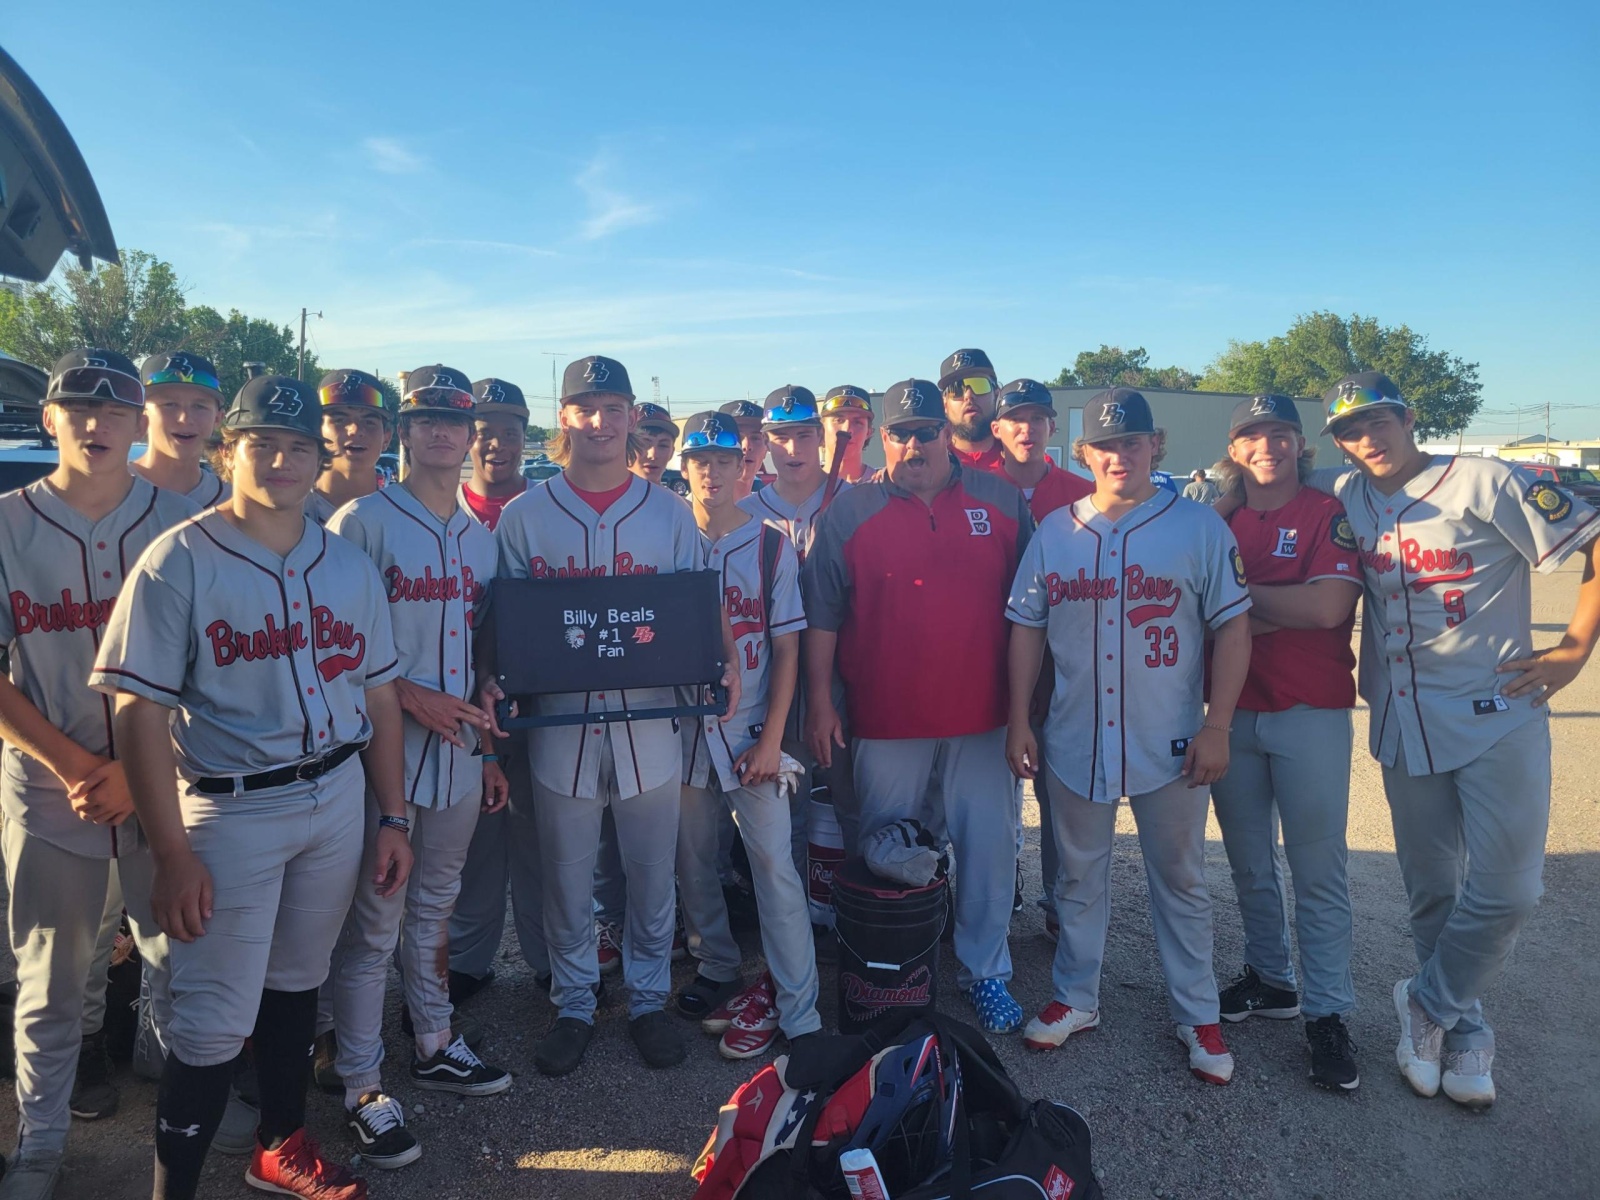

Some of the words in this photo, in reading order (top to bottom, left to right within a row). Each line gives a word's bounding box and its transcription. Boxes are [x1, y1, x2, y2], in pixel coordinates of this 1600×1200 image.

[1400, 538, 1473, 577] Bow
[385, 565, 460, 603] Broken
[1046, 568, 1118, 606] Broken
[1125, 564, 1180, 606] Bow
[563, 609, 597, 628] Billy
[607, 606, 655, 624] Beals
[1443, 589, 1466, 628] 9
[206, 613, 308, 667] Broken
[311, 606, 364, 653] Bow
[597, 644, 625, 658] Fan
[599, 627, 622, 643] #1
[1144, 626, 1179, 668] 33
[841, 972, 932, 1004] Diamond
